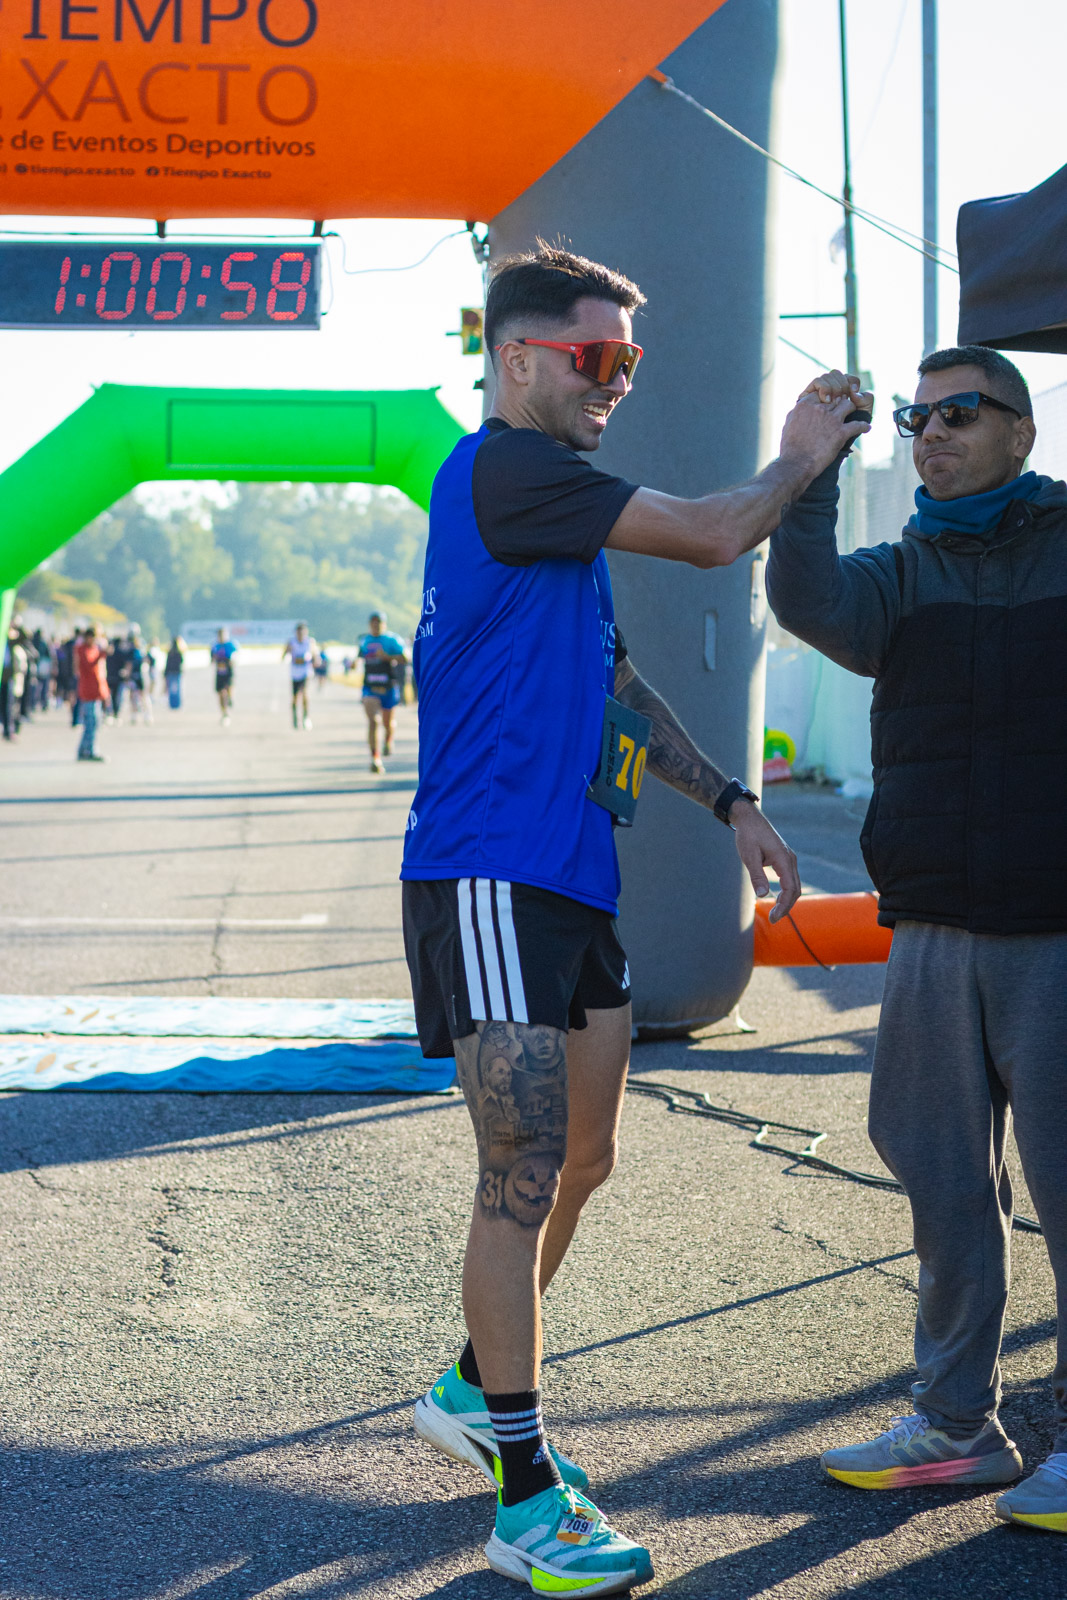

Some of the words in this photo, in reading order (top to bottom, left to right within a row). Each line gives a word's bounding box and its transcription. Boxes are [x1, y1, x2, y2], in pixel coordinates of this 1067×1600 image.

[0, 56, 319, 127] XACTO
[10, 129, 45, 150] de
[52, 130, 159, 153] Eventos
[166, 132, 317, 159] Deportivos
[162, 166, 219, 179] Tiempo
[222, 167, 272, 180] Exacto
[55, 252, 312, 321] 1:00:58
[414, 621, 434, 641] AM
